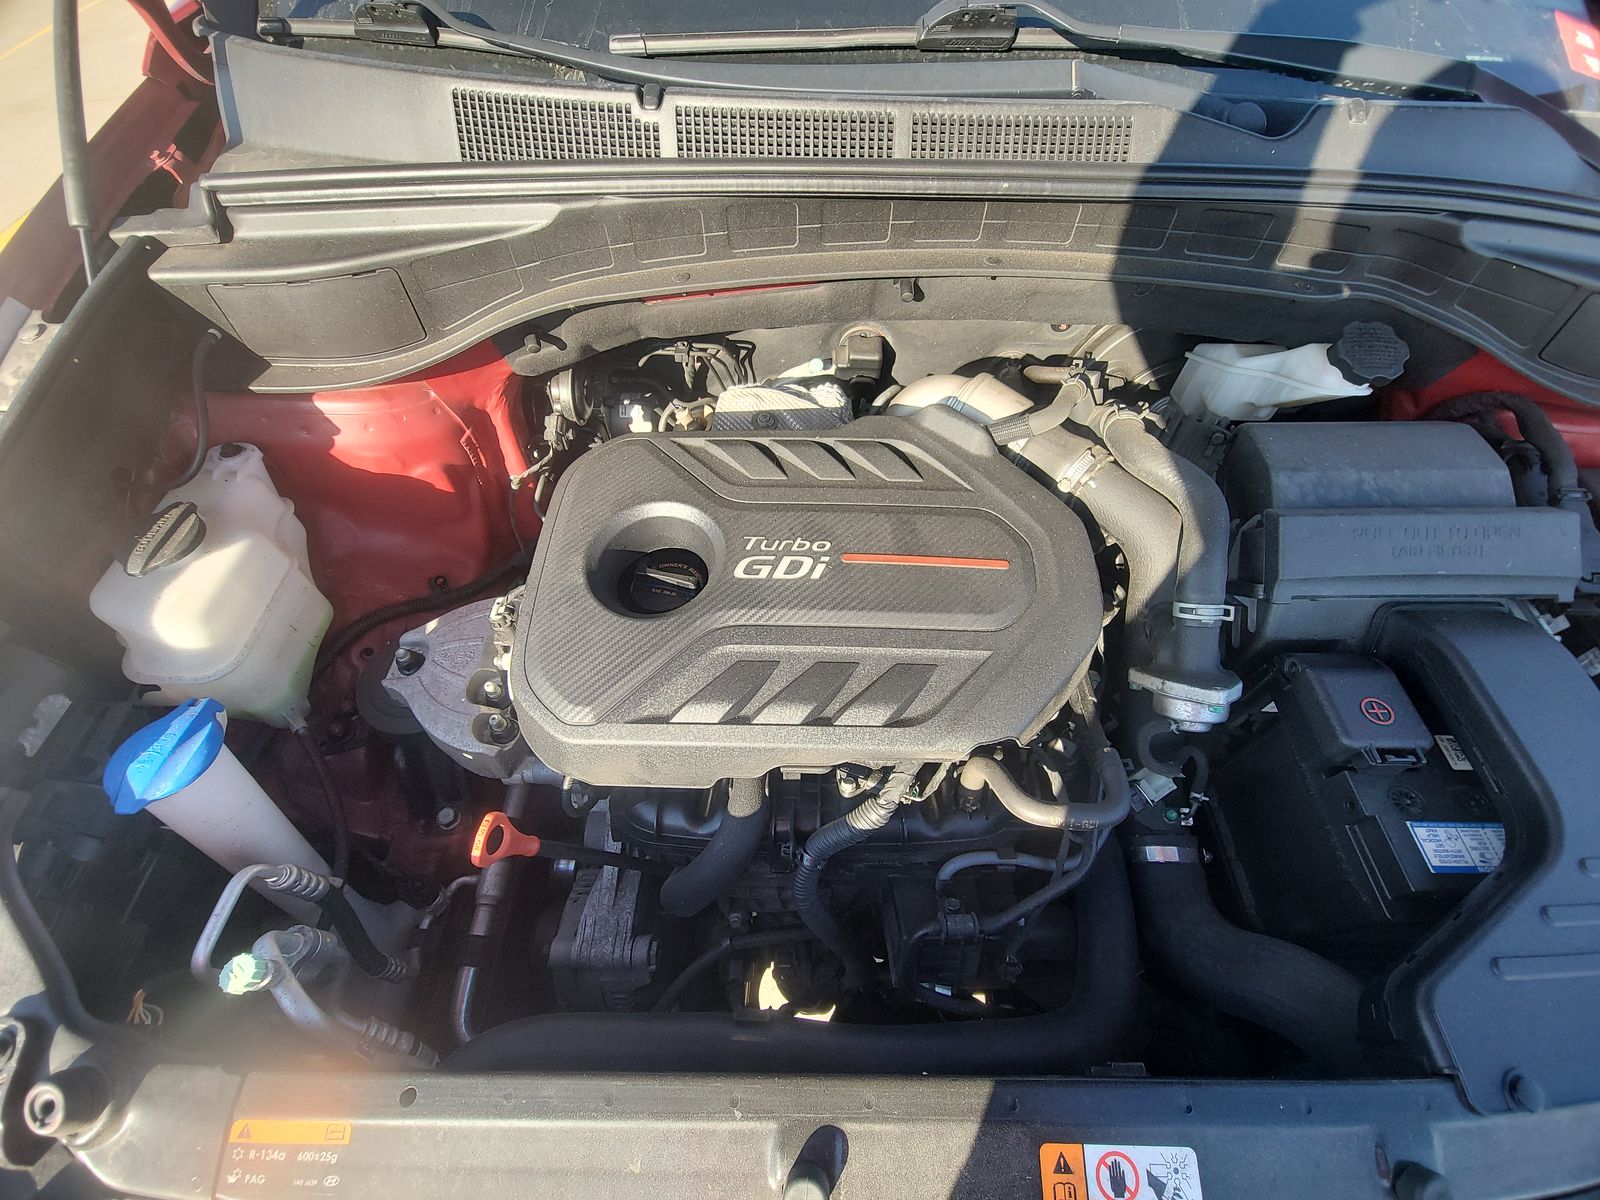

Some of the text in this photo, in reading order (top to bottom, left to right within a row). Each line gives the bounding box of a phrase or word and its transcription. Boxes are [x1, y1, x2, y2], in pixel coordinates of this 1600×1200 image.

[743, 536, 832, 552] Turbo
[733, 555, 831, 580] GDi
[248, 1149, 338, 1164] R-134a 600±25g
[244, 1174, 266, 1185] PAG
